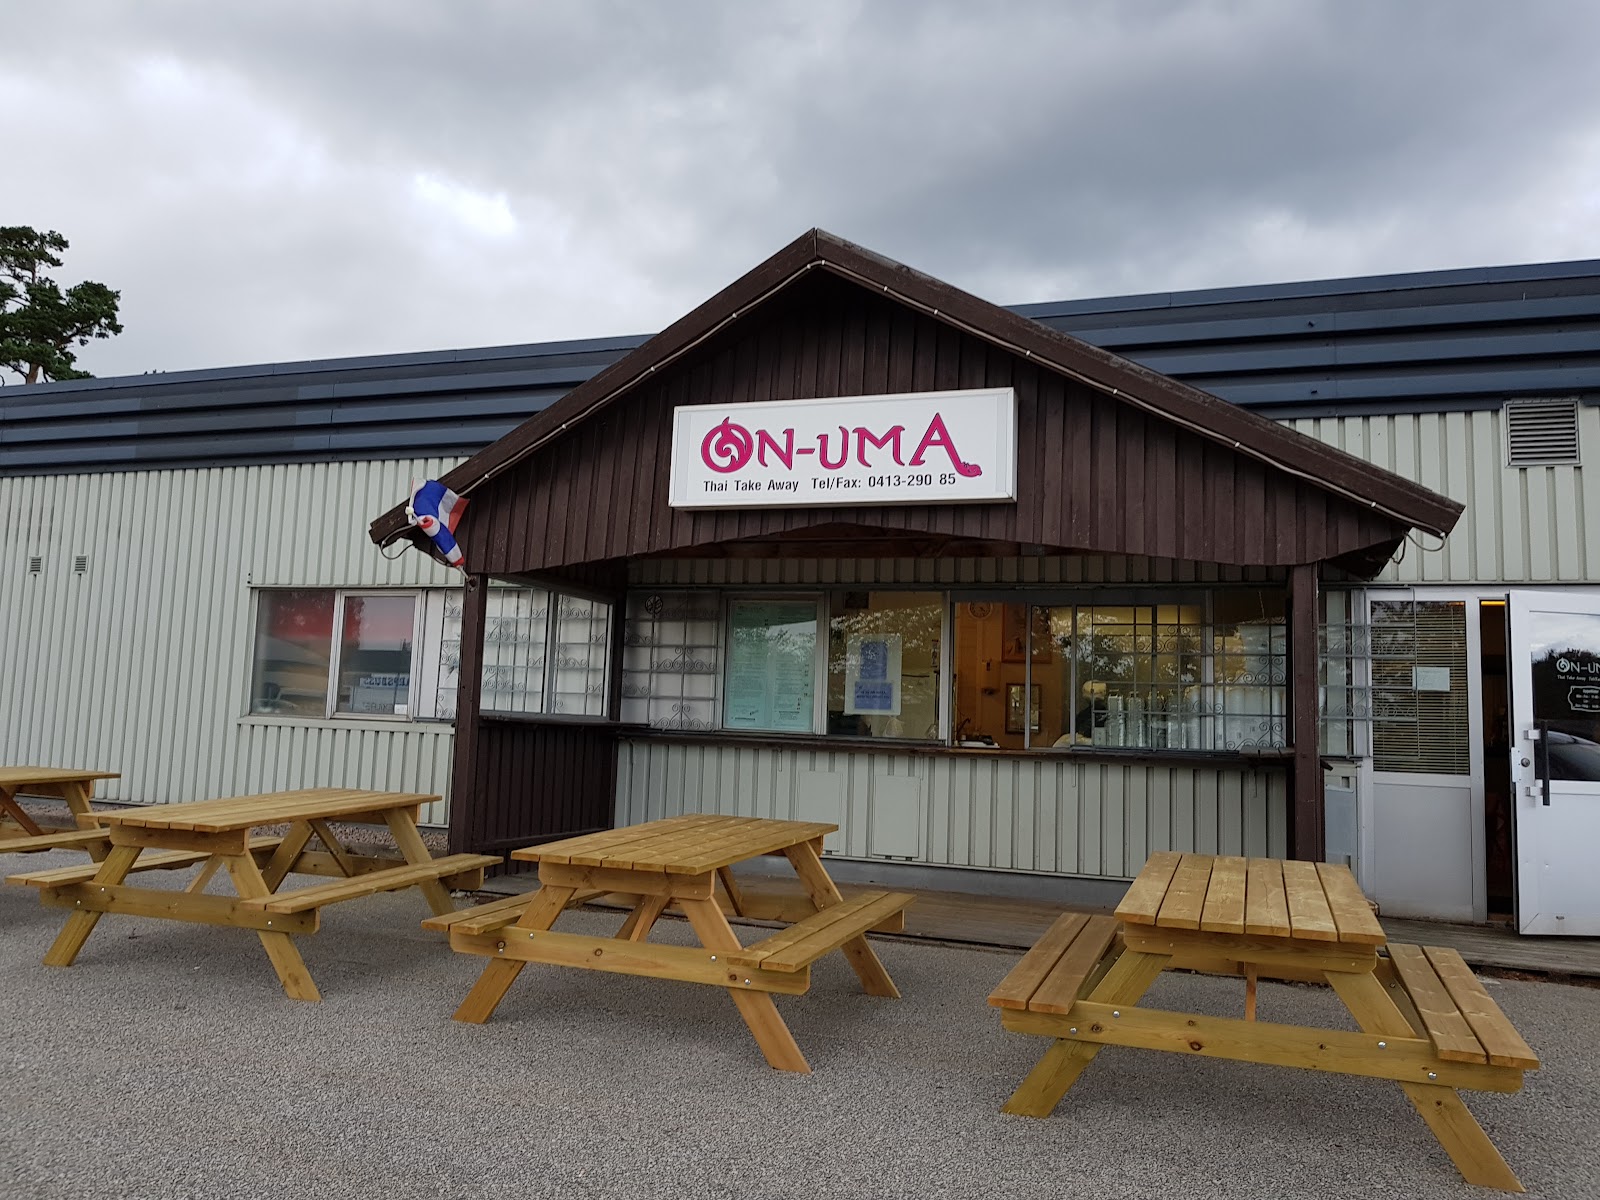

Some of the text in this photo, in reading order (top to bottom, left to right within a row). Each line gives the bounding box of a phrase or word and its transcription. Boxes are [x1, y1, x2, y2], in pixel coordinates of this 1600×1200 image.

[701, 412, 982, 477] ON-UMA
[703, 473, 956, 493] Thai Take Away Tel/Fax: 0413-290 85
